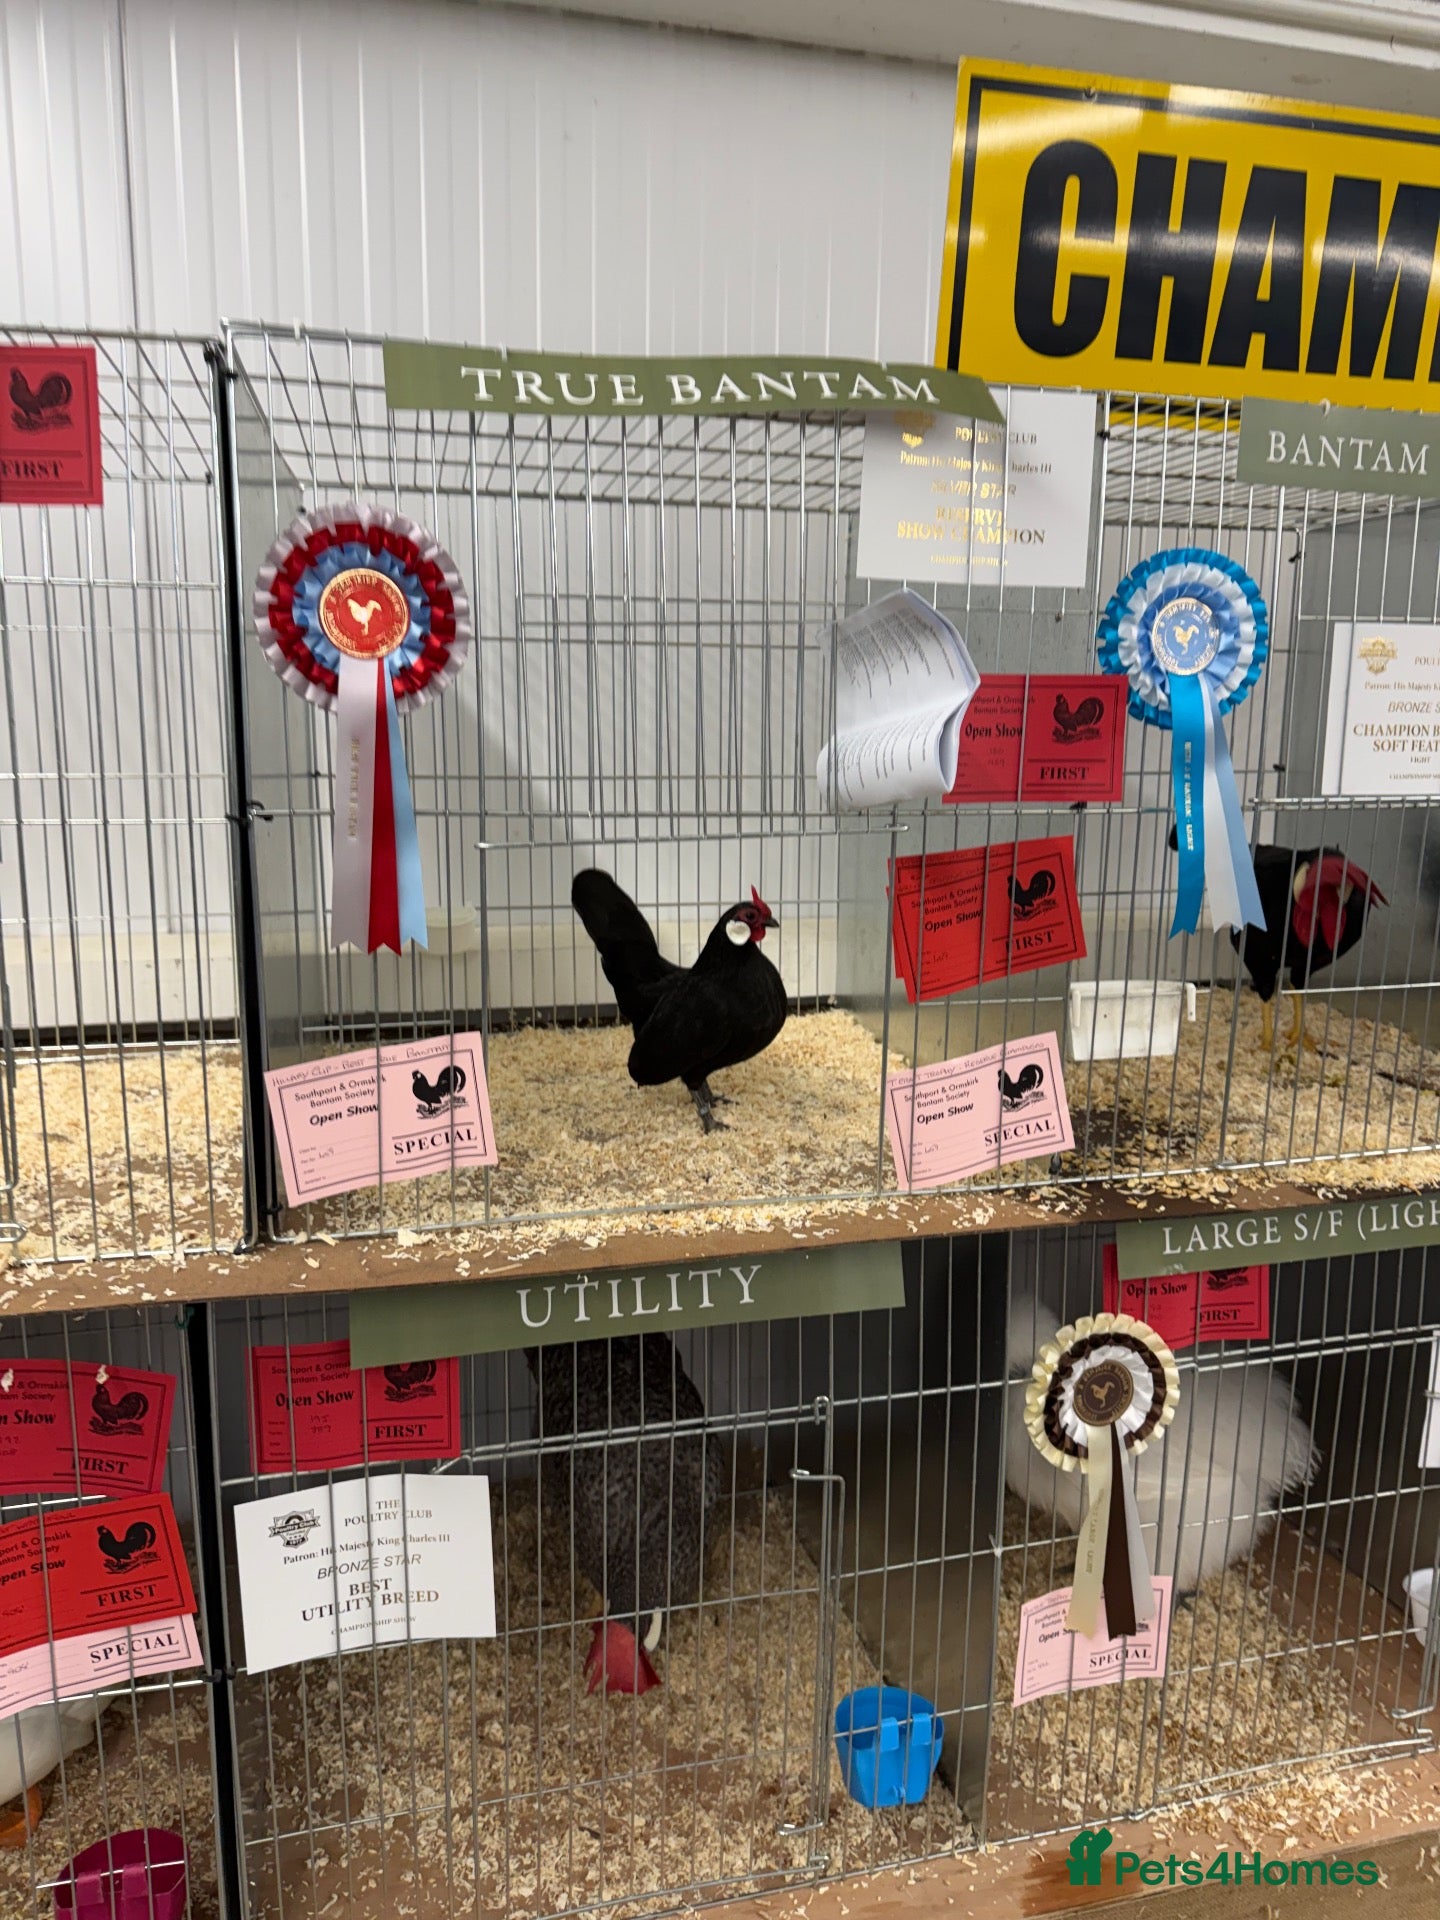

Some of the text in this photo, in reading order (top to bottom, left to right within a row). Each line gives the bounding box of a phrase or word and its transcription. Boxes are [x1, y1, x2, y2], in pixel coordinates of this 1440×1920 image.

[1014, 139, 1440, 383] CHAM
[461, 366, 940, 406] TRUE BANTAM
[1266, 430, 1430, 475] BANTAM
[1012, 461, 1038, 473] harles
[897, 521, 945, 541] SHOW
[1388, 701, 1431, 713] BRONZE
[965, 722, 1023, 740] Open Show
[1353, 724, 1430, 737] CHAMPION
[1373, 740, 1408, 752] SOFT
[1040, 767, 1089, 780] FIRST
[924, 909, 984, 933] Open Show
[294, 1085, 337, 1102] Southport
[340, 1083, 346, 1091] &
[948, 1077, 979, 1091] Ormskirk
[310, 1088, 375, 1108] Bantam Society
[917, 1090, 970, 1109] Bantam Society
[309, 1103, 379, 1127] Open Show
[917, 1103, 974, 1125] Open Show
[393, 1128, 477, 1156] SPECIAL
[984, 1119, 1056, 1147] SPECIAL
[1162, 1216, 1281, 1255] LARGE
[1294, 1209, 1344, 1241] S/F
[515, 1264, 762, 1328] UTILITY
[1161, 1282, 1188, 1296] Show
[1199, 1309, 1240, 1323] FIRST
[285, 1376, 318, 1384] antam
[276, 1390, 354, 1410] Open Show
[13, 1409, 57, 1425] Show
[374, 1424, 428, 1438] FIRST
[72, 1456, 128, 1474] FIRST
[375, 1500, 400, 1510] THE
[283, 1551, 319, 1565] Patron:
[377, 1537, 400, 1547] King
[438, 1534, 450, 1543] III
[317, 1553, 422, 1579] BRONZE STAR
[0, 1569, 26, 1586] pen
[349, 1577, 393, 1596] BEST
[98, 1583, 157, 1606] FIRST
[302, 1590, 440, 1621] UTILITY BREED
[1038, 1631, 1060, 1643] Open
[91, 1633, 180, 1664] SPECIAL
[1089, 1649, 1151, 1668] SPECIAL
